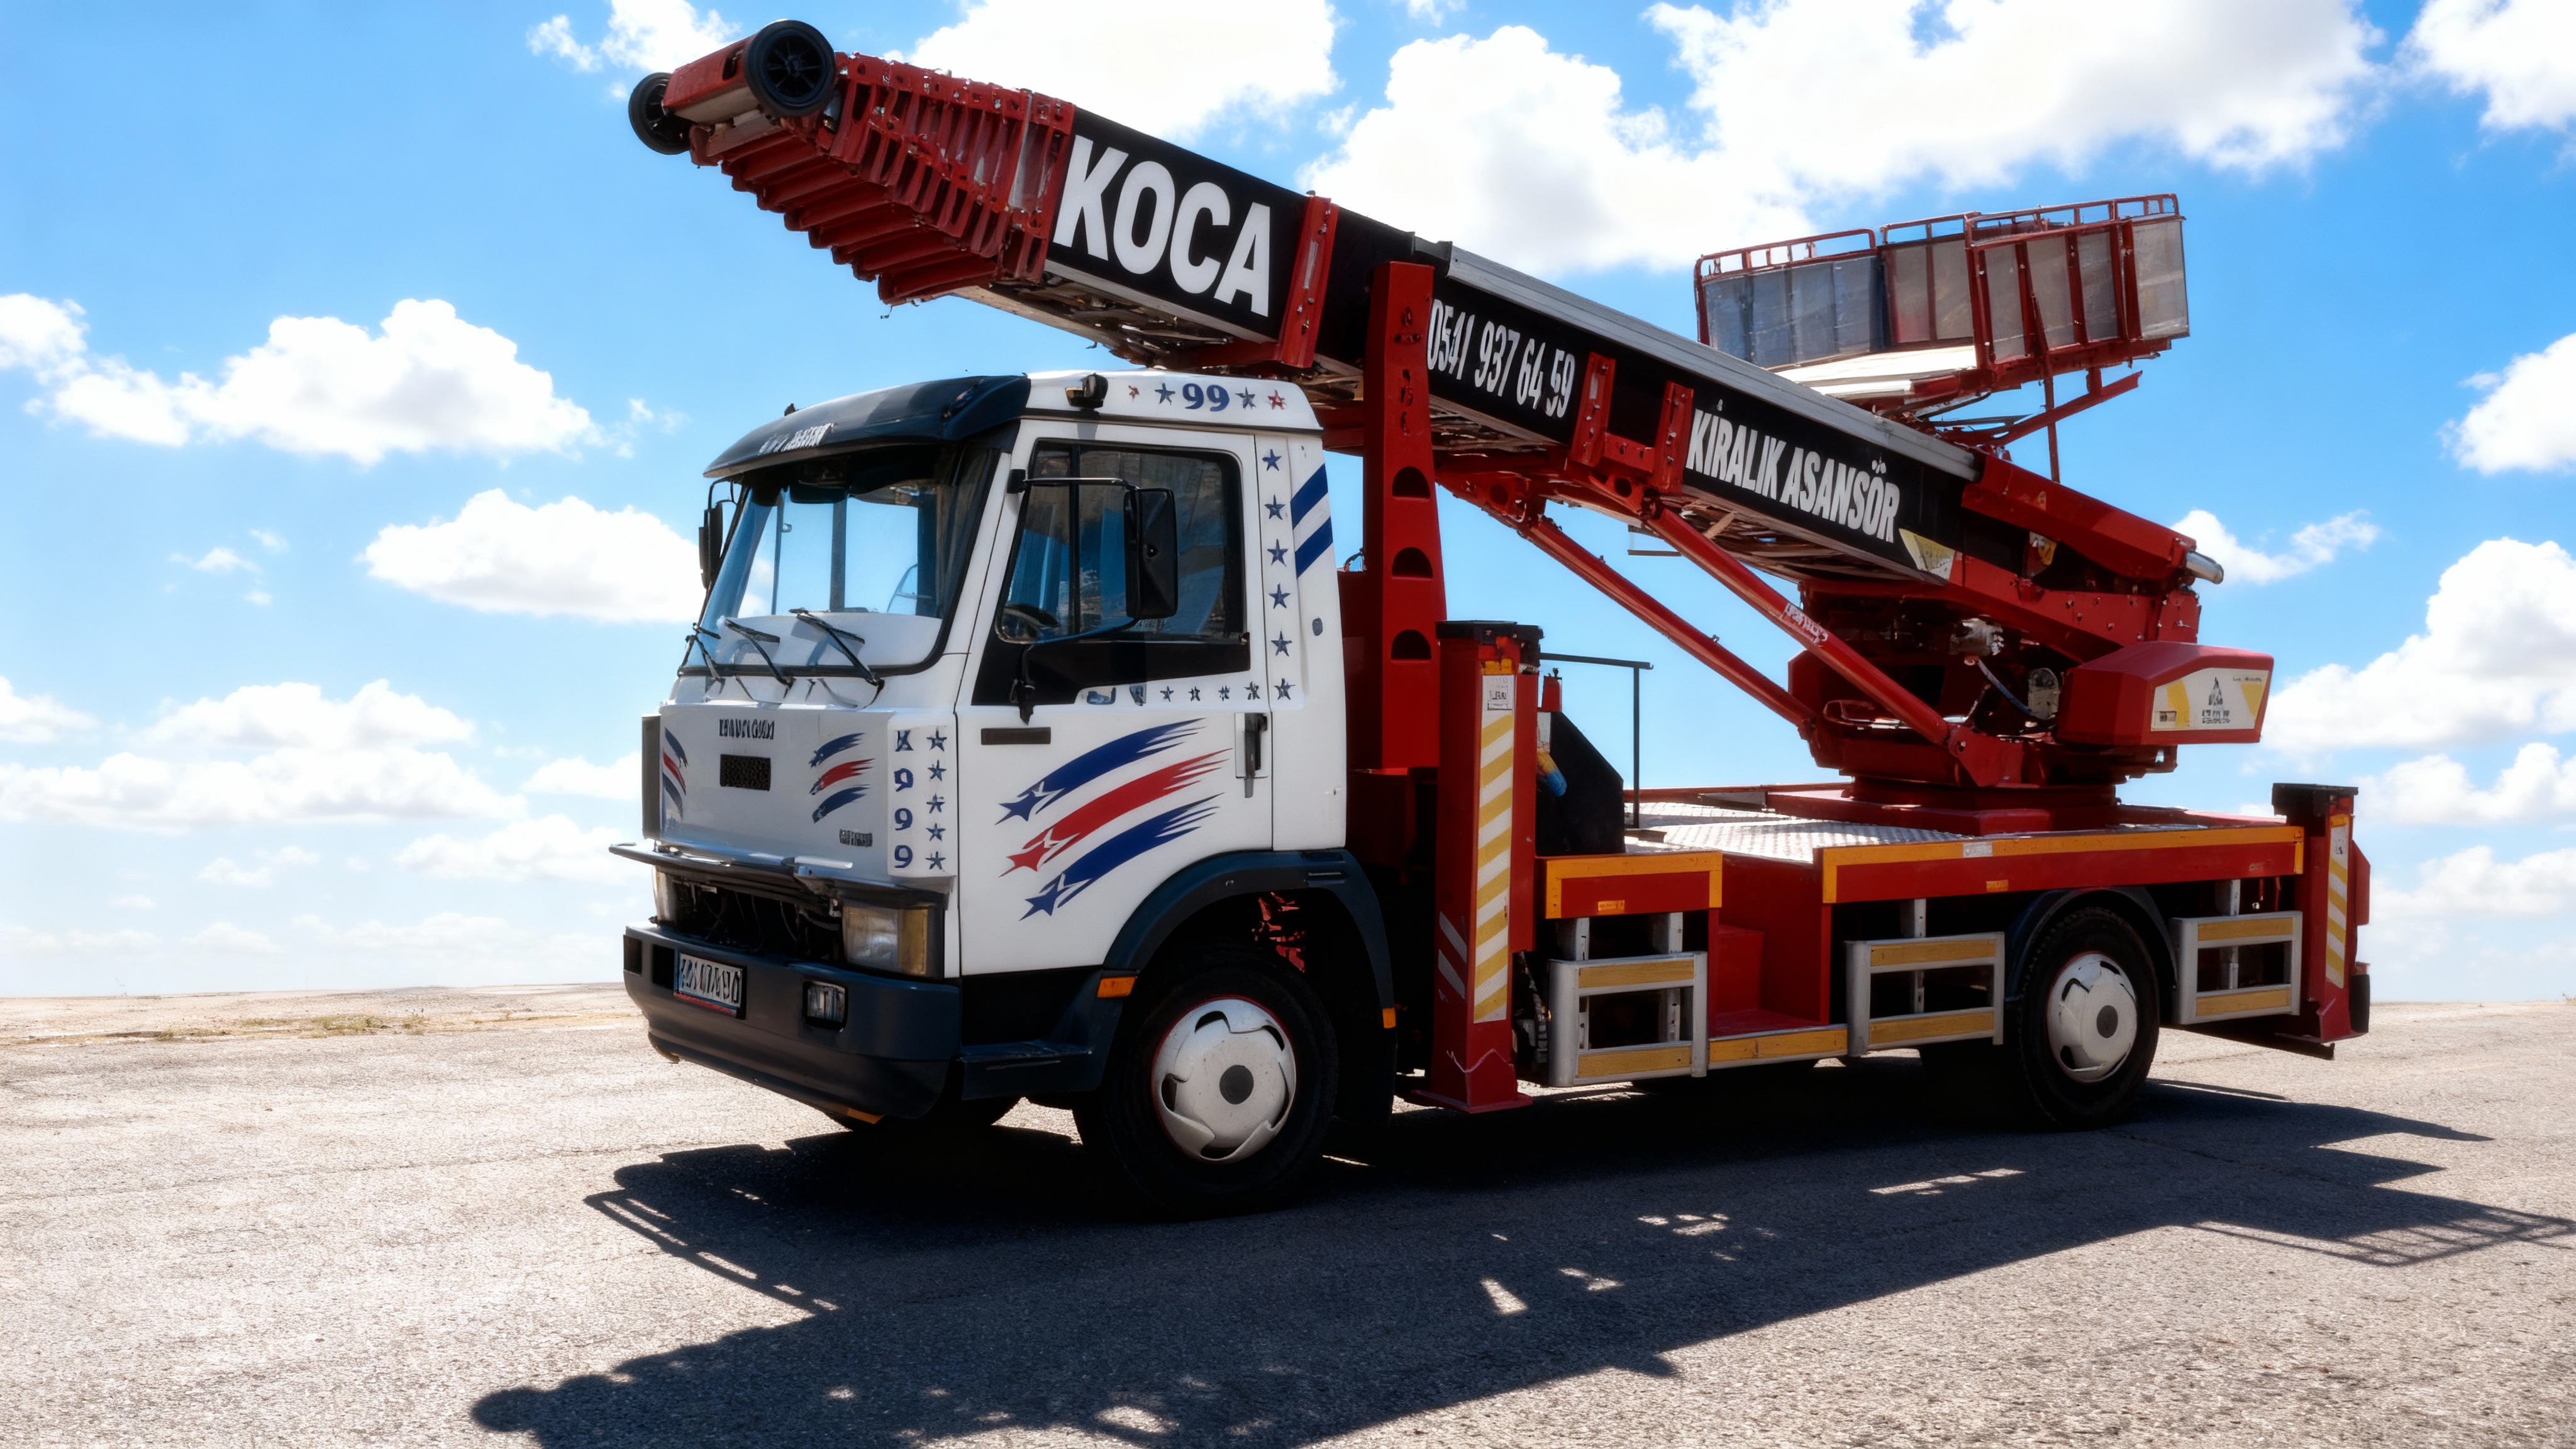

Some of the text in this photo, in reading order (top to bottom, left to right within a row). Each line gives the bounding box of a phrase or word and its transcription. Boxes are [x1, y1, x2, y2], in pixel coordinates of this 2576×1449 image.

[1052, 134, 1271, 318] KOCA
[1182, 382, 1230, 412] 99
[1427, 299, 1575, 418] 0541 937 64 59
[1779, 447, 1901, 544] ASANSÖR
